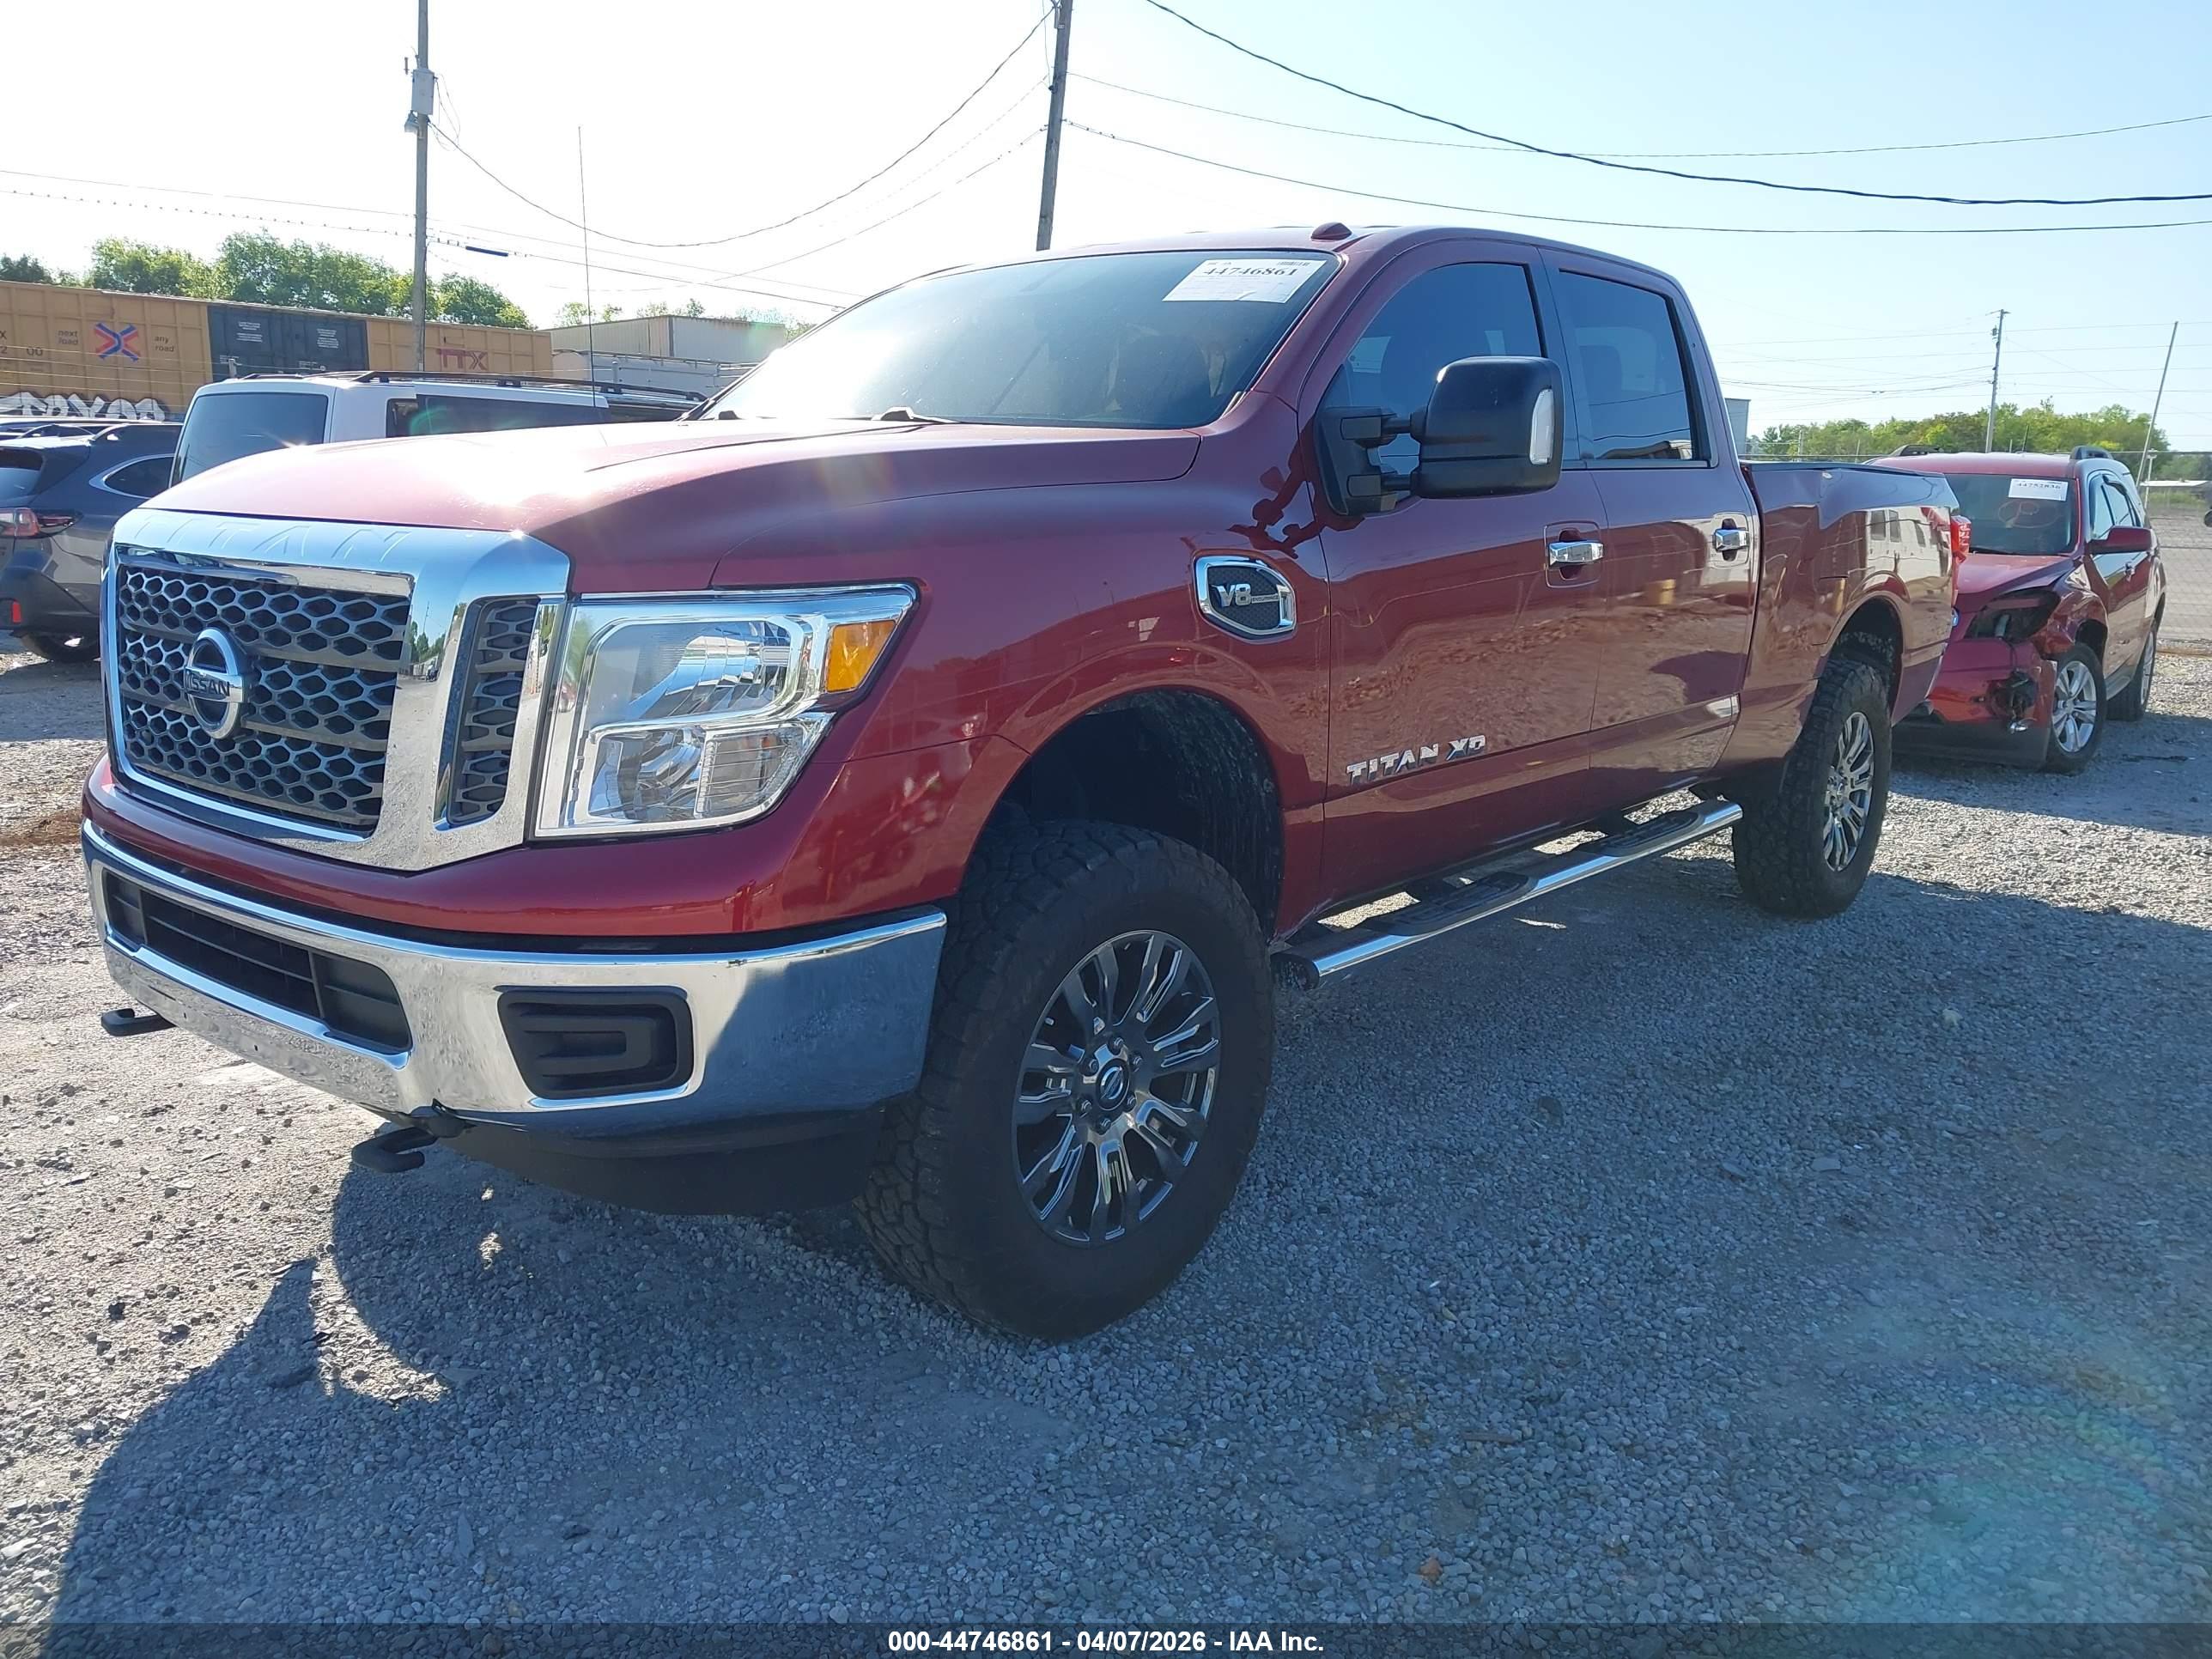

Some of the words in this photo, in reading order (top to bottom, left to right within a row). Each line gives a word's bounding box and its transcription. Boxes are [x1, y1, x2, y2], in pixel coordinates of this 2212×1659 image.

[1203, 267, 1299, 276] 44746861
[155, 335, 169, 343] any
[1212, 584, 1251, 607] V8
[1346, 744, 1439, 785] TITAN
[1446, 735, 1486, 762] XD
